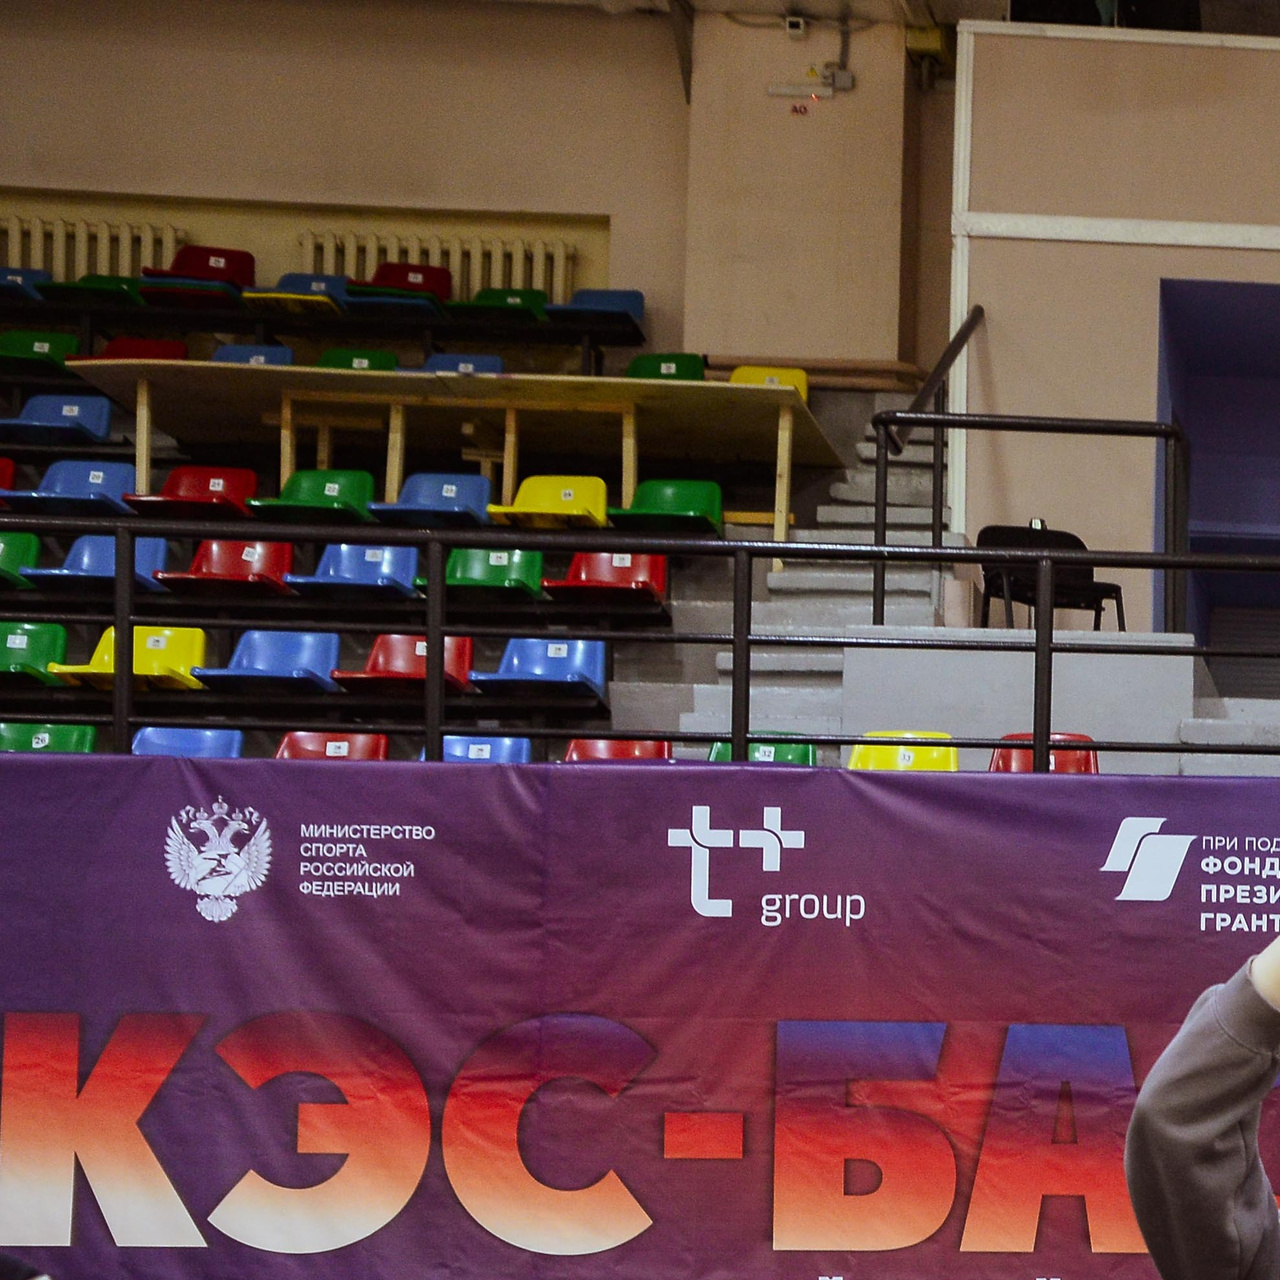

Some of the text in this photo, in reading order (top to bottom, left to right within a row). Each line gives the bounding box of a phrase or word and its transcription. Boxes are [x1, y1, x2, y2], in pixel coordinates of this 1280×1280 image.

[34, 734, 46, 745] 26
[300, 823, 436, 840] МИНИСТЕРСТВО
[300, 842, 367, 858] СПОРТА
[1202, 836, 1238, 850] ПРИ
[300, 860, 415, 877] РОССИЙСКОЙ
[299, 881, 401, 898] ФЕДЕРАЦИИ
[760, 893, 866, 927] group
